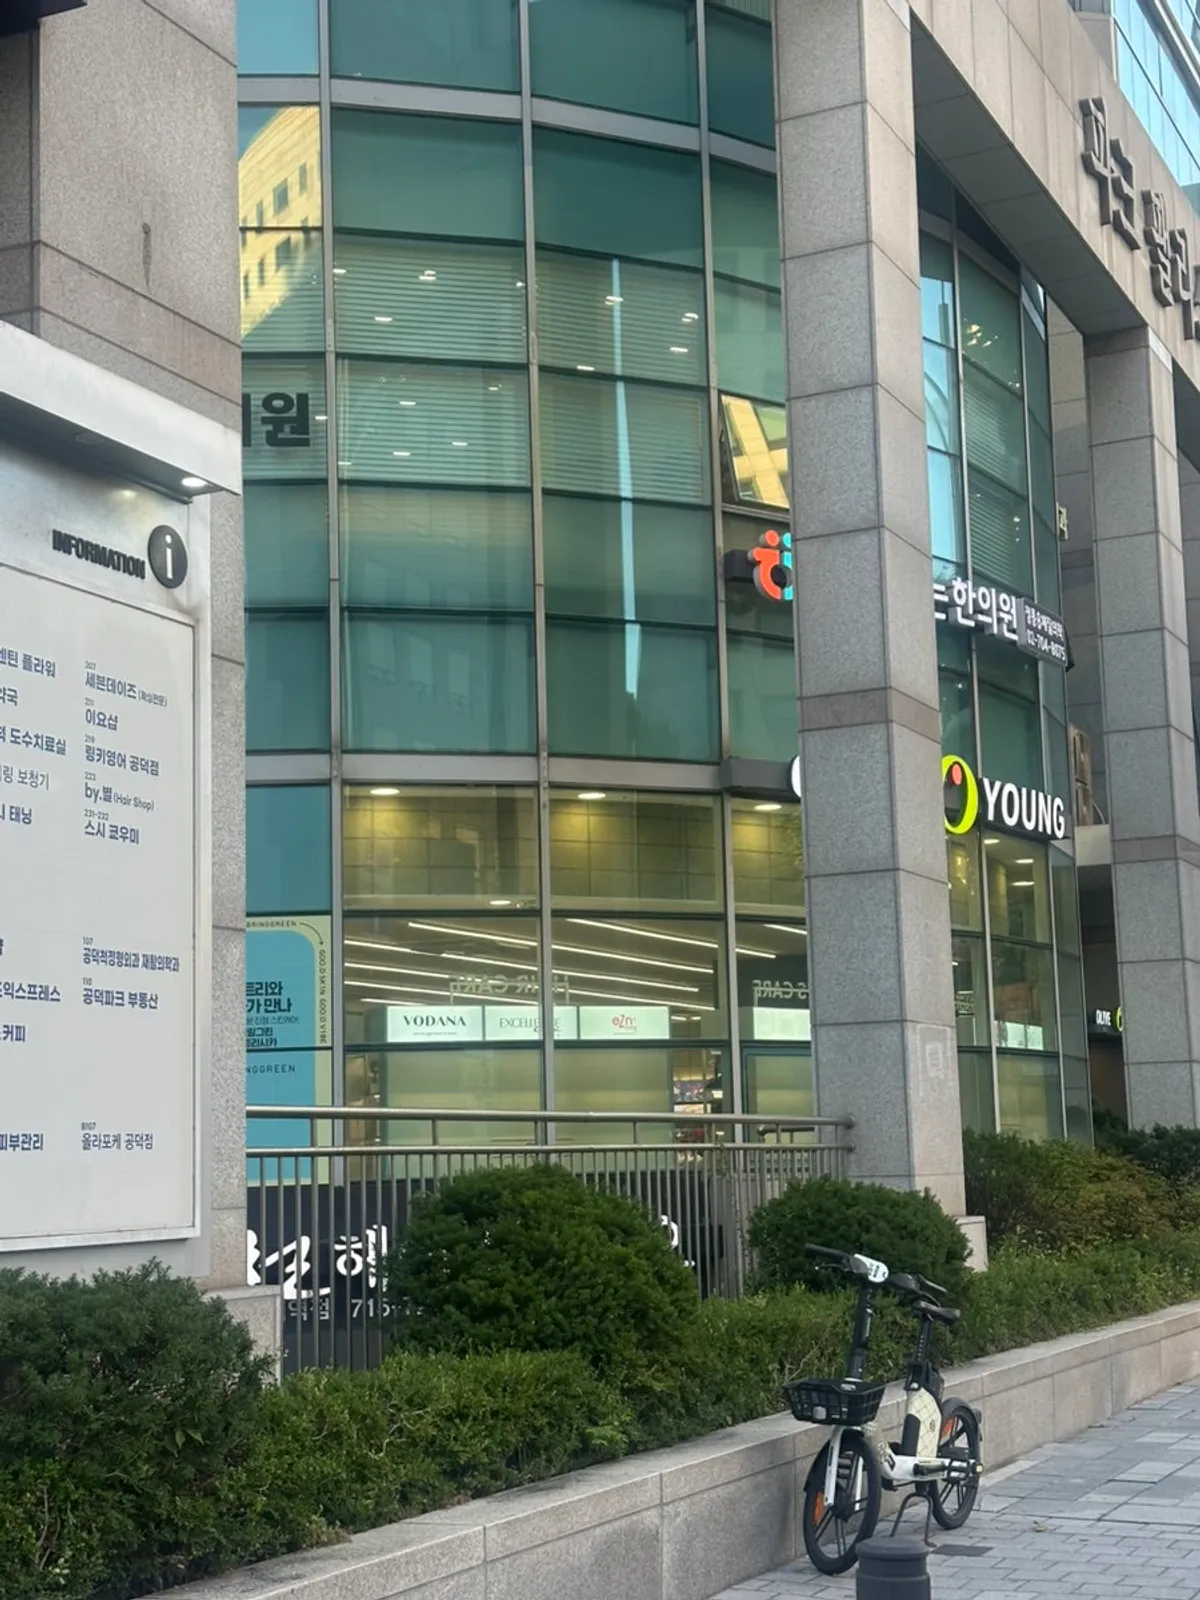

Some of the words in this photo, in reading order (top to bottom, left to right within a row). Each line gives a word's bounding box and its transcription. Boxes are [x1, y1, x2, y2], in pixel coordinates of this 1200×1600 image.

[1078, 96, 1200, 341] 파크팰리
[52, 529, 146, 580] INFORMATION
[22, 653, 56, 678] 플라워
[85, 671, 137, 700] 세븐데이즈
[85, 708, 118, 731] 이요샵
[9, 727, 67, 756] 도수치료실
[129, 756, 160, 777] 공덕점
[17, 768, 50, 791] 보청기
[9, 805, 32, 825] 태닝
[982, 776, 1065, 839] YOUNG
[84, 819, 106, 839] 스시
[82, 987, 125, 1008] 공덕파크
[128, 991, 160, 1010] 부동산
[264, 997, 292, 1013] 만나
[403, 1014, 467, 1027] VODANA
[0, 1023, 27, 1043] 커피
[81, 1132, 121, 1151] 올라포케
[124, 1132, 154, 1151] 공덕점
